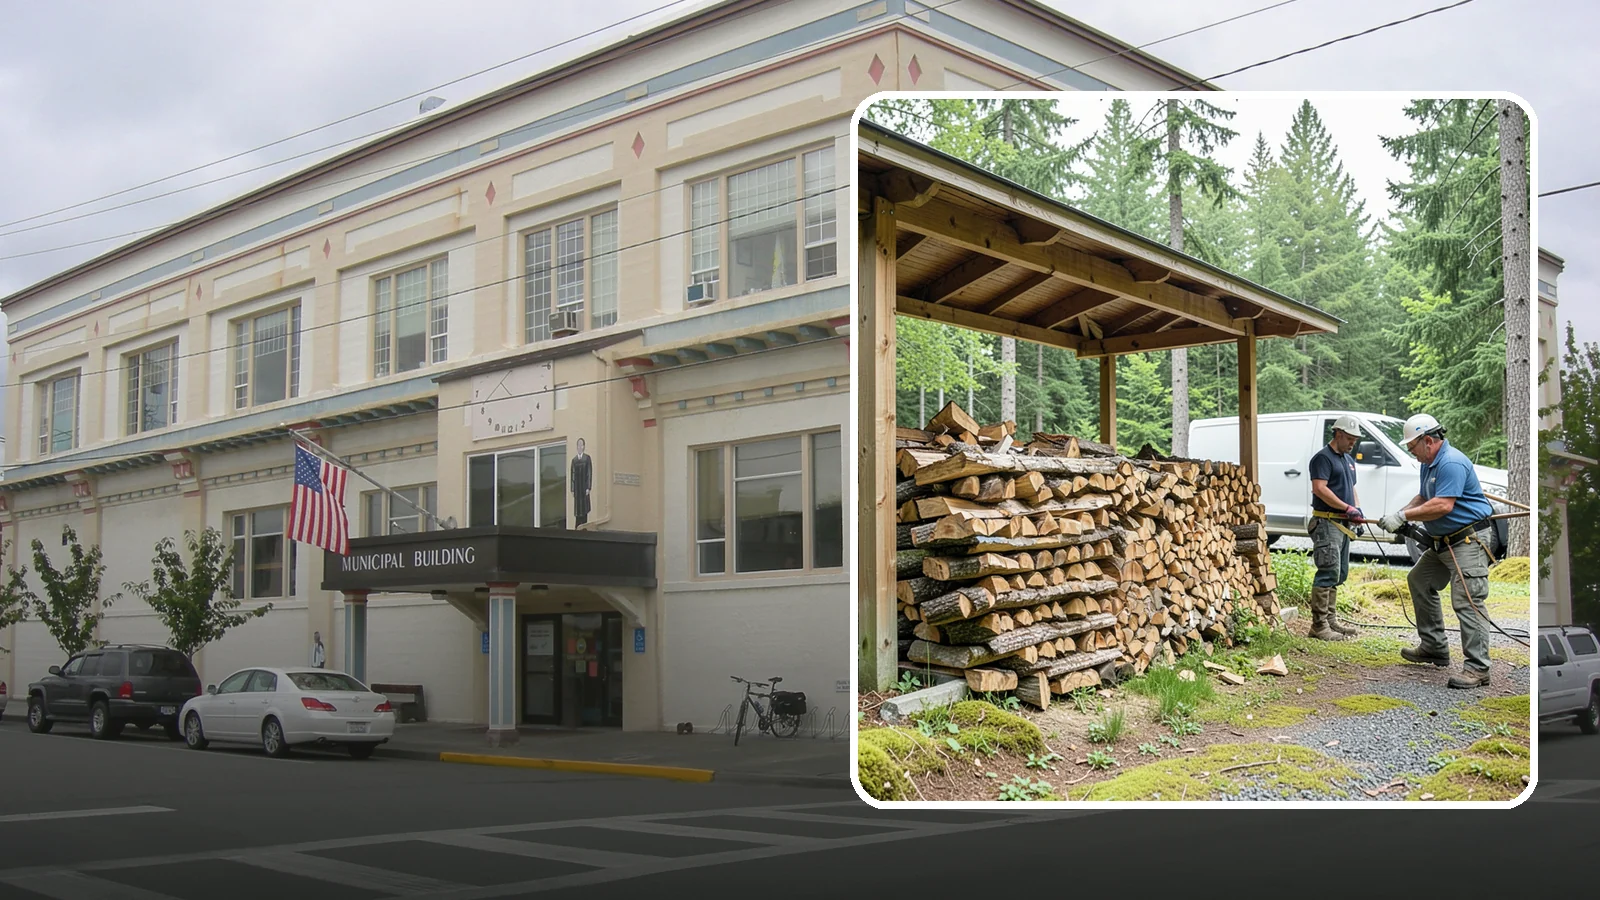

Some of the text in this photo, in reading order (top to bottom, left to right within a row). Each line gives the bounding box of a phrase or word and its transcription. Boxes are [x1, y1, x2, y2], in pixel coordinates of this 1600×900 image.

[521, 420, 526, 428] 2
[342, 546, 475, 572] MUNICIPAL BUILDING
